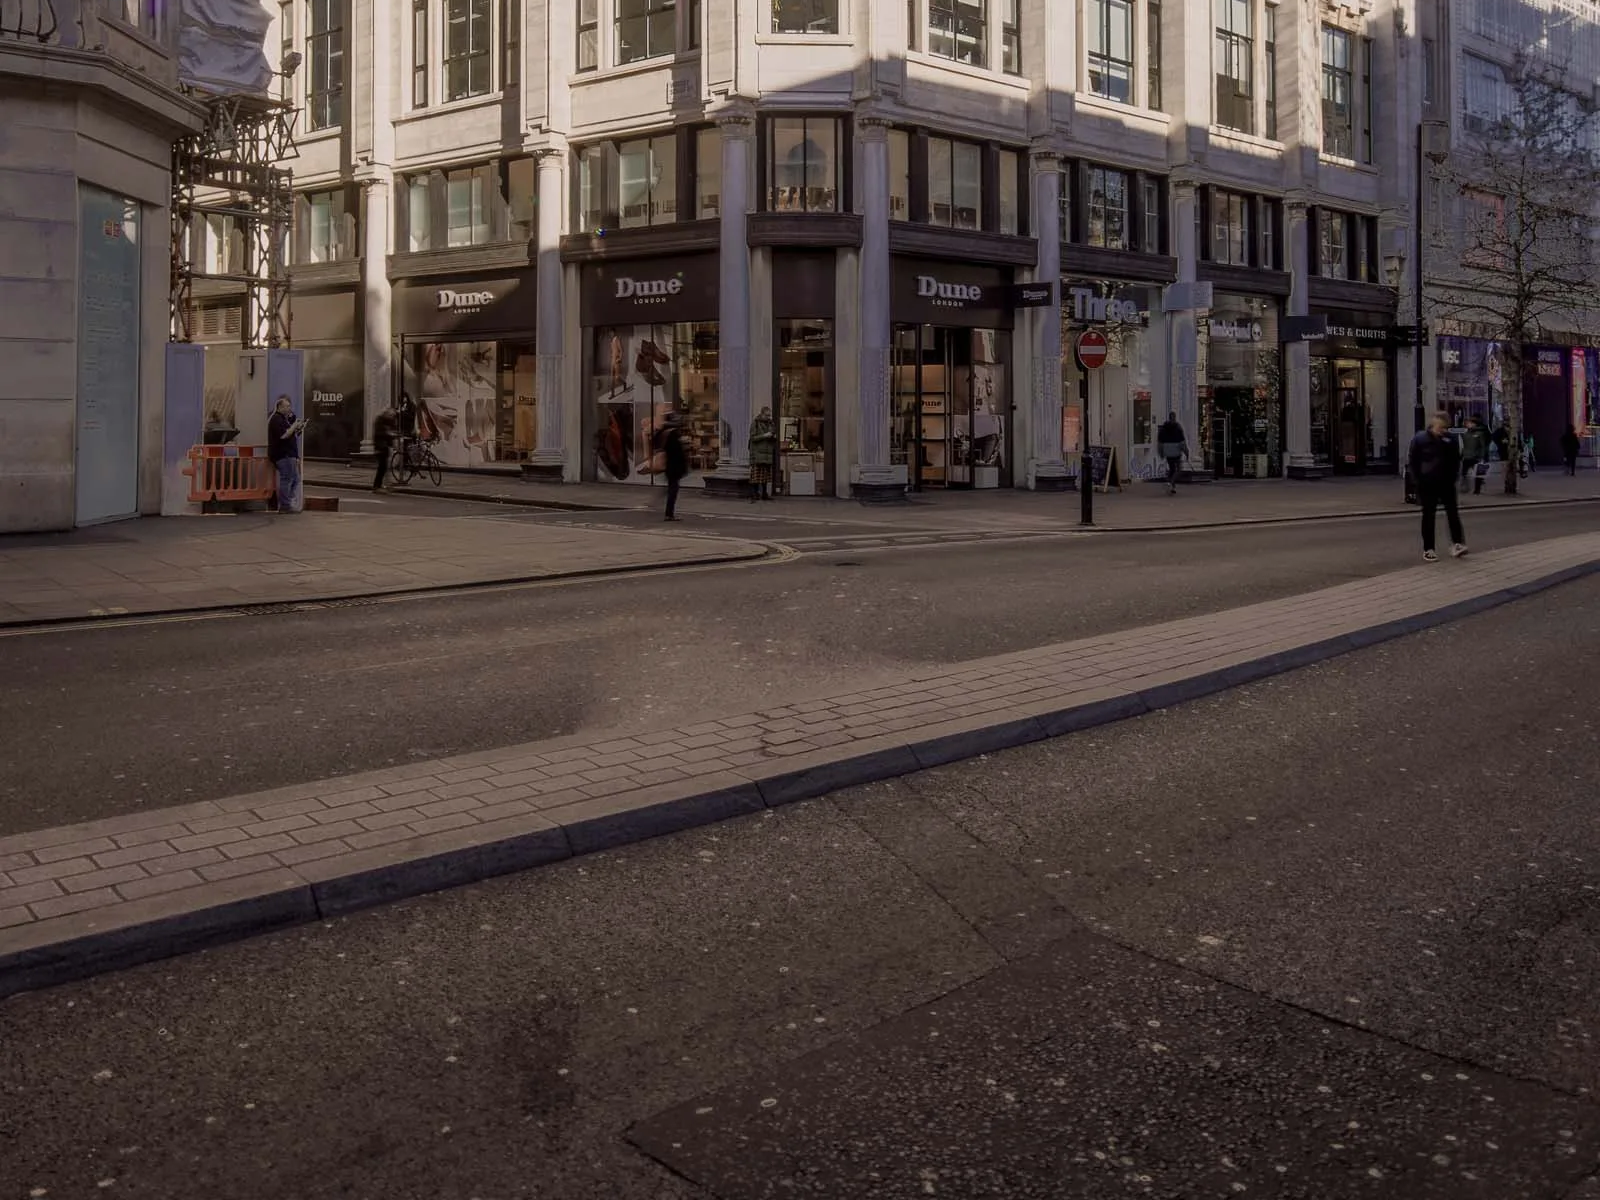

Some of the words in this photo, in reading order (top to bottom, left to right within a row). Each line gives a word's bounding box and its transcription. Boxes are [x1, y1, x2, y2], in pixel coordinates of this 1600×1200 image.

[616, 277, 684, 298] Dune
[918, 275, 982, 300] Dune
[438, 289, 494, 308] Dune
[634, 297, 667, 305] LONDON
[932, 299, 964, 307] LONDON
[1069, 287, 1137, 321] Three
[312, 390, 343, 402] Dune
